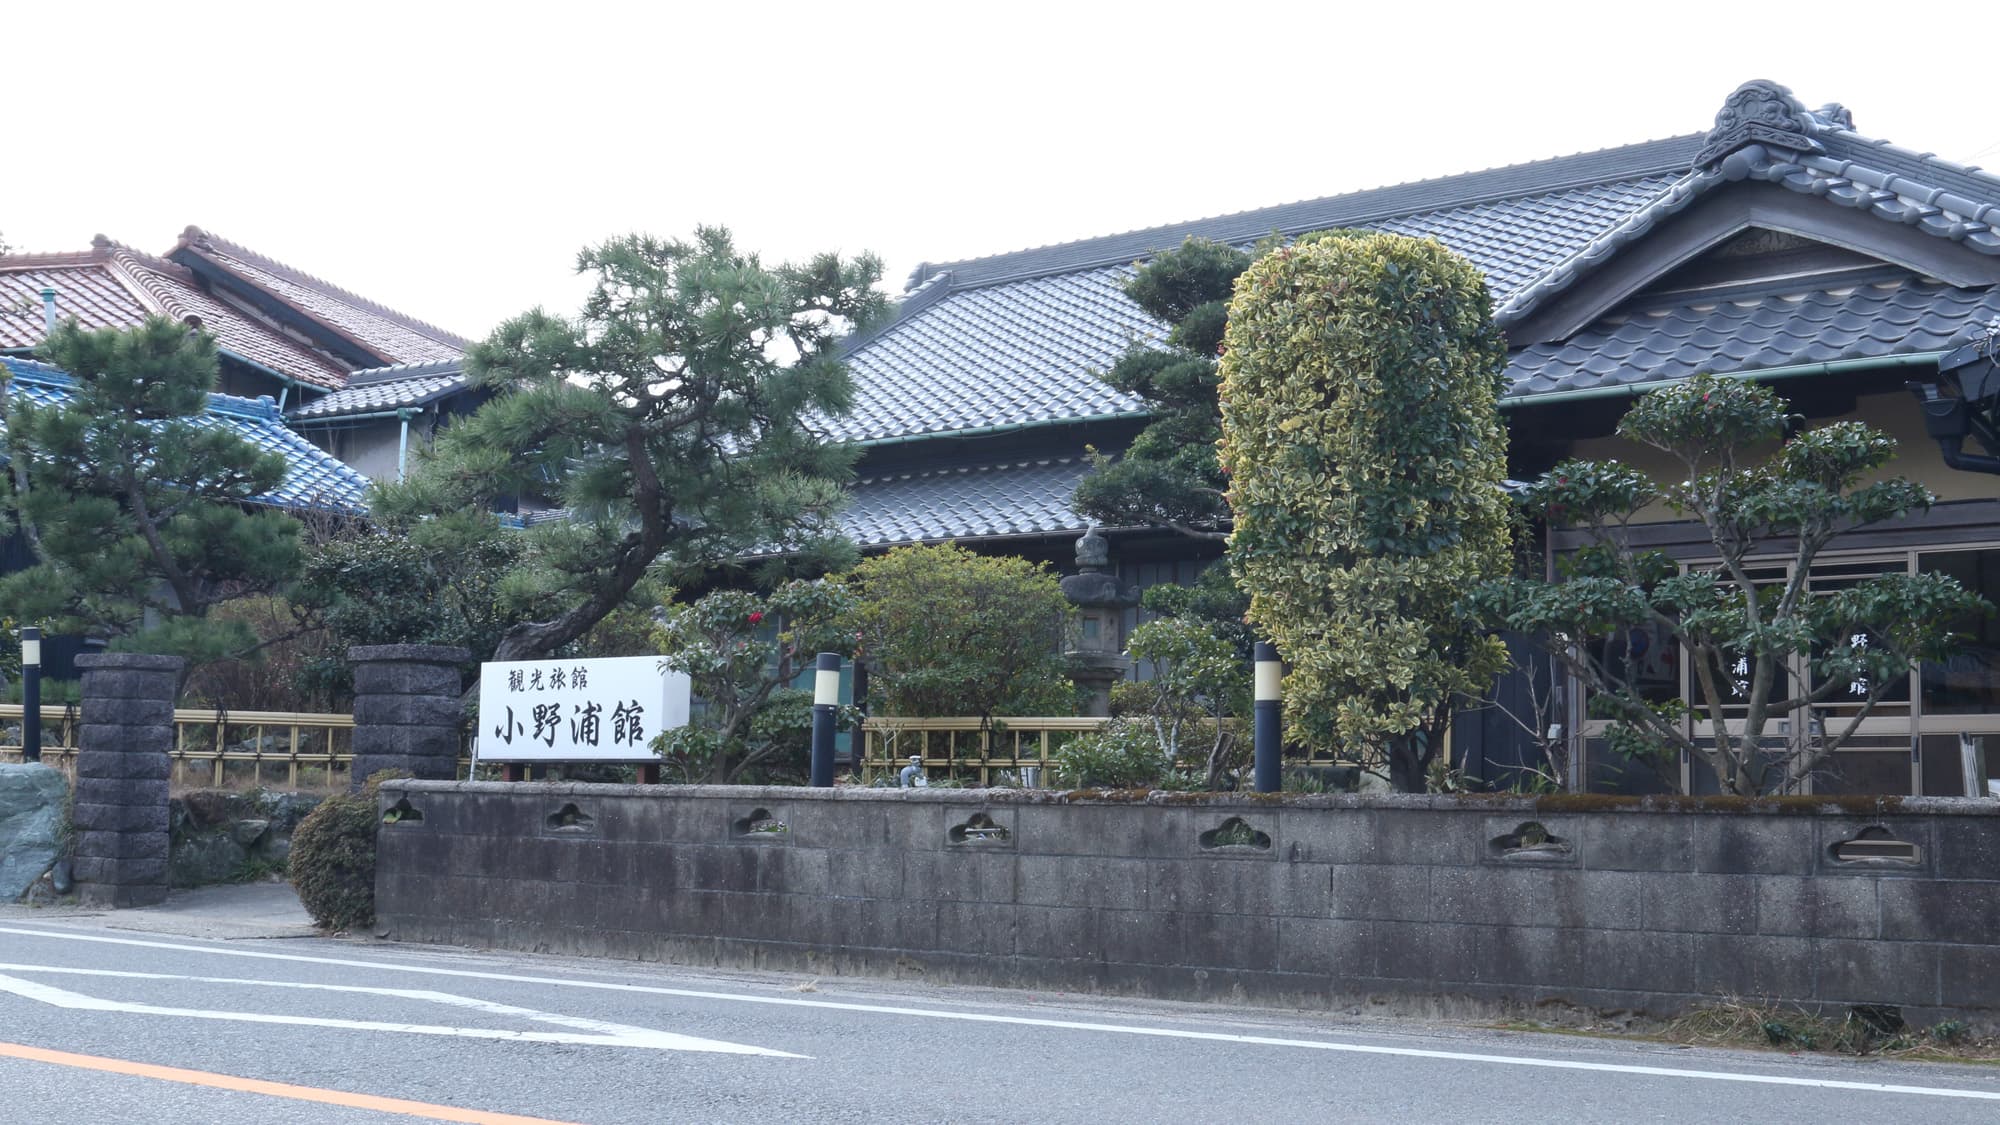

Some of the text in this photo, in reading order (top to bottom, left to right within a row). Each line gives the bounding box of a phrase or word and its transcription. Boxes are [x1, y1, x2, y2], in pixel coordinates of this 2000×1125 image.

[508, 666, 588, 693] 観光旅館
[495, 699, 645, 748] 小野浦館
